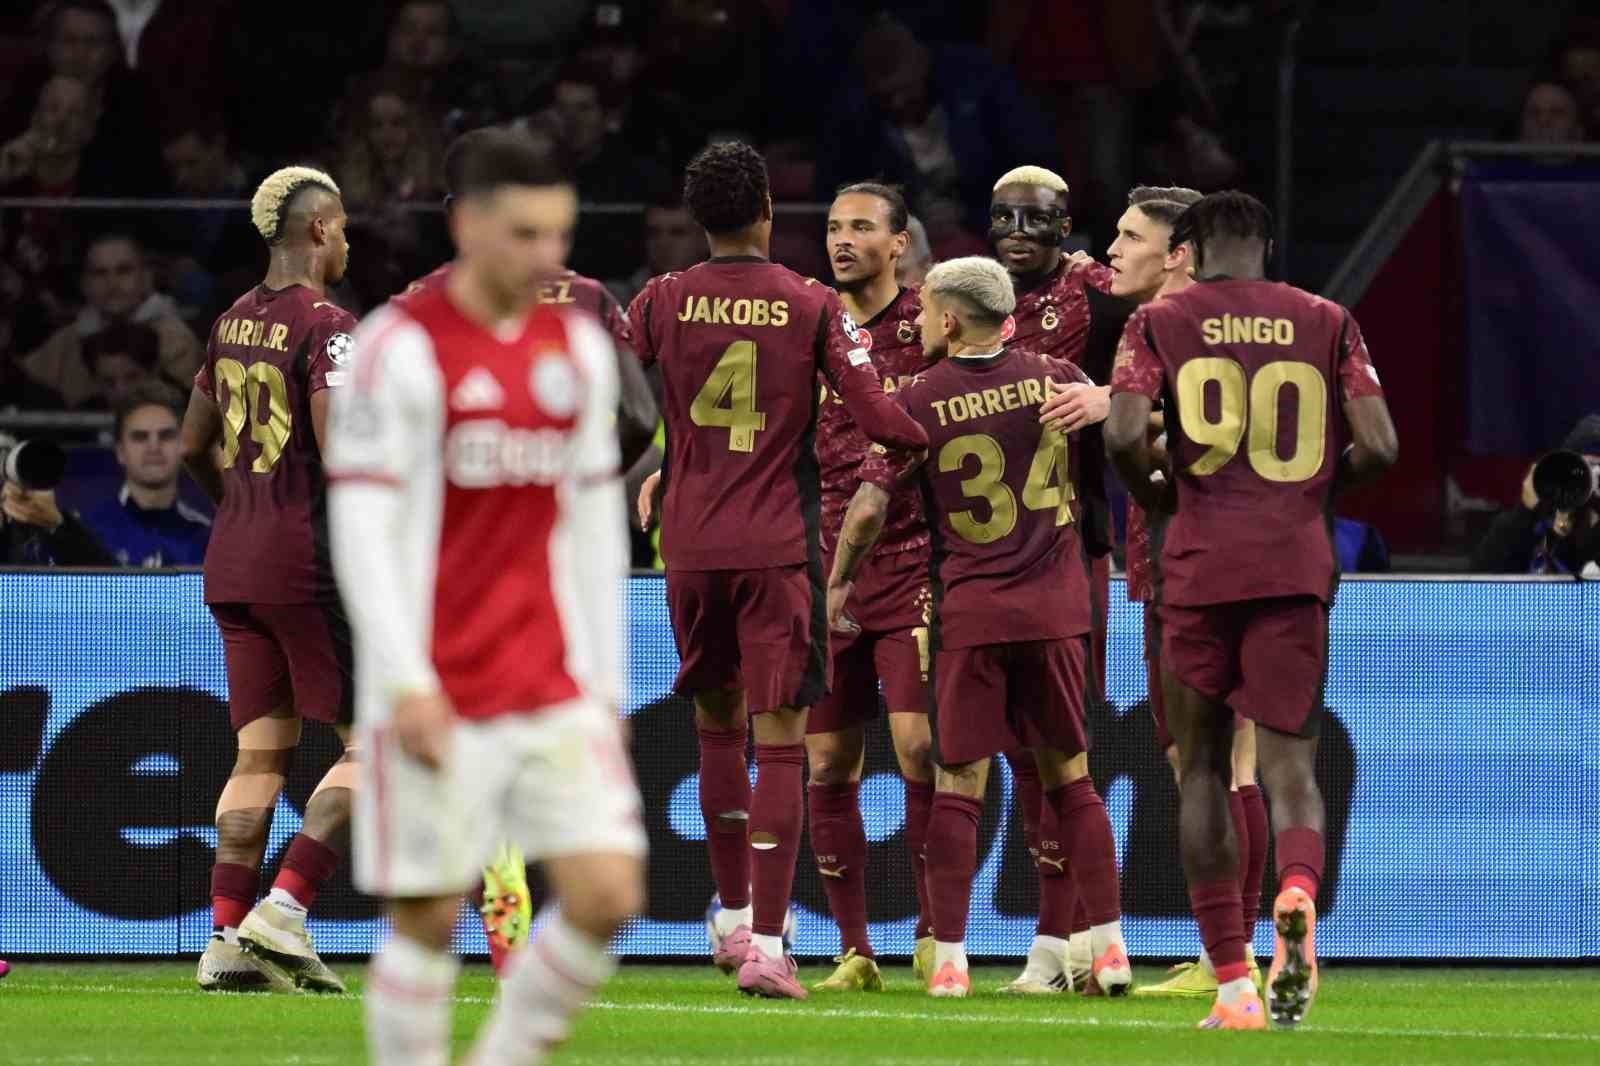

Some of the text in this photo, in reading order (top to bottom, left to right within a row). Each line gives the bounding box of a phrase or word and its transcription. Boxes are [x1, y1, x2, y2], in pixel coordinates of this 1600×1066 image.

[263, 323, 288, 352] JR.
[677, 295, 790, 326] JAKOBS
[215, 358, 292, 473] 99
[690, 340, 766, 453] 4
[931, 375, 1058, 426] TORREIRA
[1176, 357, 1327, 482] 90
[938, 420, 1076, 544] 34
